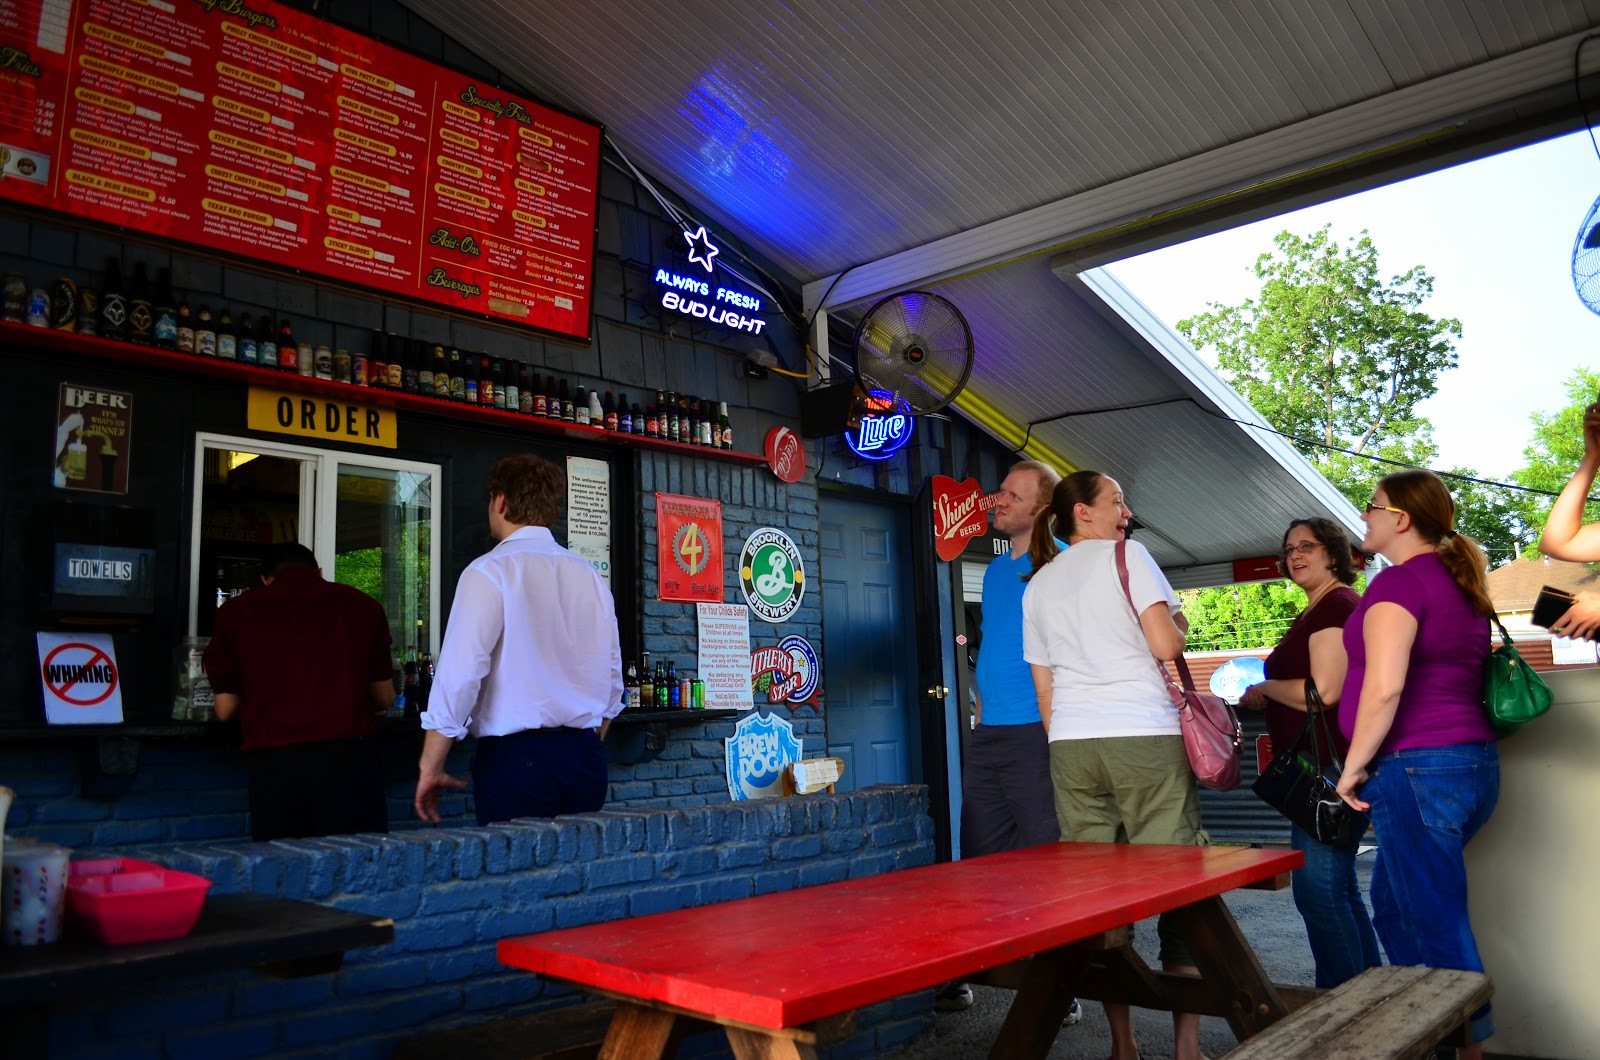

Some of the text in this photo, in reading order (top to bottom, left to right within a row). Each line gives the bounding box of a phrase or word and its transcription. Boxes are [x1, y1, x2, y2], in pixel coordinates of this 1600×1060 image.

[220, 0, 277, 29] Burgers
[89, 26, 165, 57] TRIPLE HEART CLOGGER
[226, 25, 248, 39] PHILLY
[83, 58, 178, 93] QUADRUPLE HEART CLOGGER
[221, 64, 239, 76] FRITO
[252, 74, 276, 88] BURGER
[79, 91, 131, 111] GREEK BURGER
[217, 99, 264, 119] STICKY BURGER
[461, 86, 531, 125] Specialty Fries
[74, 132, 146, 157] MUFFALETTA BURGER
[214, 133, 287, 161] STICKY MONKEY BURGER
[72, 173, 95, 185] BLACK
[104, 182, 121, 191] BLUE
[122, 186, 150, 198] BURGER
[258, 181, 282, 193] BURGER
[334, 168, 387, 190] HANGOVER BURGER
[439, 186, 456, 196] BACON
[207, 201, 267, 223] TEXAS BBQ BURGER
[331, 208, 353, 219] SLIDERS
[516, 212, 530, 221] TEXAS
[329, 240, 370, 256] STICKY SLIDERS
[429, 229, 481, 256] Add-Ons
[482, 239, 499, 249] FRIED
[499, 244, 511, 252] EGG
[525, 261, 544, 270] Grilled
[544, 265, 573, 278] Mushrooms
[526, 251, 544, 261] Grilled
[544, 256, 563, 266] Onions
[428, 268, 481, 299] Beverages
[488, 281, 499, 289] Old
[499, 282, 520, 294] Fashion
[520, 288, 536, 298] Glass
[525, 269, 542, 279] Bacon
[555, 278, 574, 288] Cheese
[488, 289, 505, 299] Bottle
[506, 294, 522, 304] Water
[655, 268, 760, 312] ALWAYS FRESH
[65, 387, 128, 409] BEER
[277, 396, 380, 440] ORDER
[91, 425, 125, 437] DINNER
[857, 414, 905, 451] Lite
[934, 490, 979, 537] Shiner
[959, 522, 981, 537] BEERS
[680, 522, 703, 577] 4
[746, 532, 798, 560] BROOKLYN
[71, 559, 131, 580] TOWELS
[691, 583, 719, 594] Real Ale
[699, 605, 748, 620] For Your Childs Safety
[749, 591, 799, 618] BREWERY
[47, 664, 114, 684] WHINING
[727, 678, 747, 686] Property
[771, 674, 798, 702] STAR
[737, 730, 779, 758] BREW
[739, 750, 778, 779] DOG
